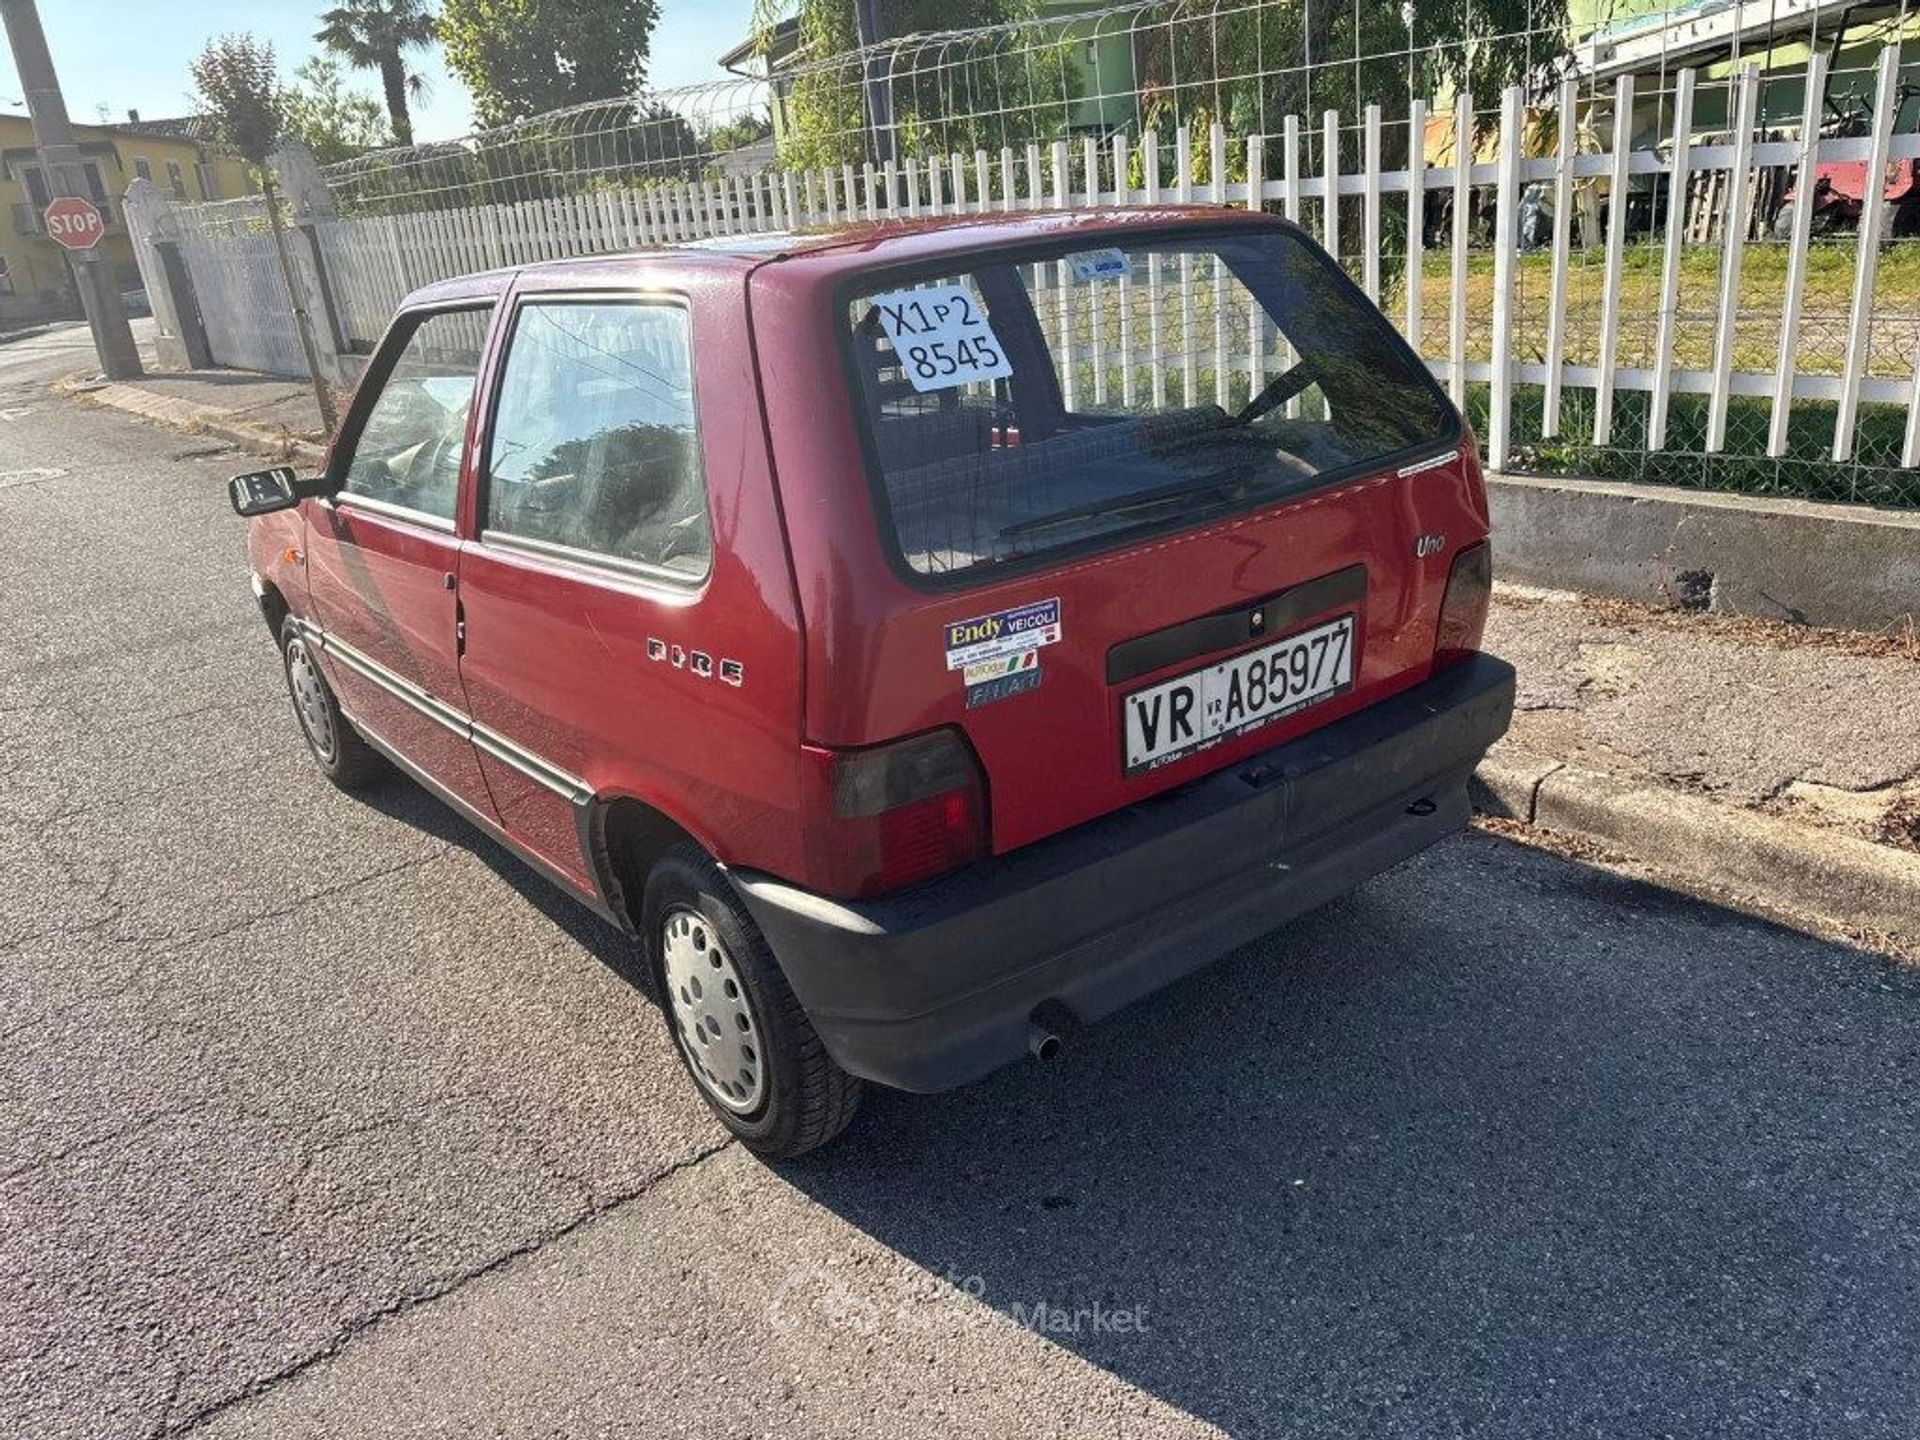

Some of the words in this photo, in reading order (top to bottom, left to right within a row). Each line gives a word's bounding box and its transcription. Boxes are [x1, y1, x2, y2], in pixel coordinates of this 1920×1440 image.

[49, 212, 97, 234] STOP
[909, 336, 999, 379] 8545
[951, 617, 1005, 646] Endy
[1008, 610, 1056, 633] VEICOLI
[647, 637, 743, 688] FIRE
[1137, 685, 1195, 752] VR
[1225, 626, 1350, 724] A85977
